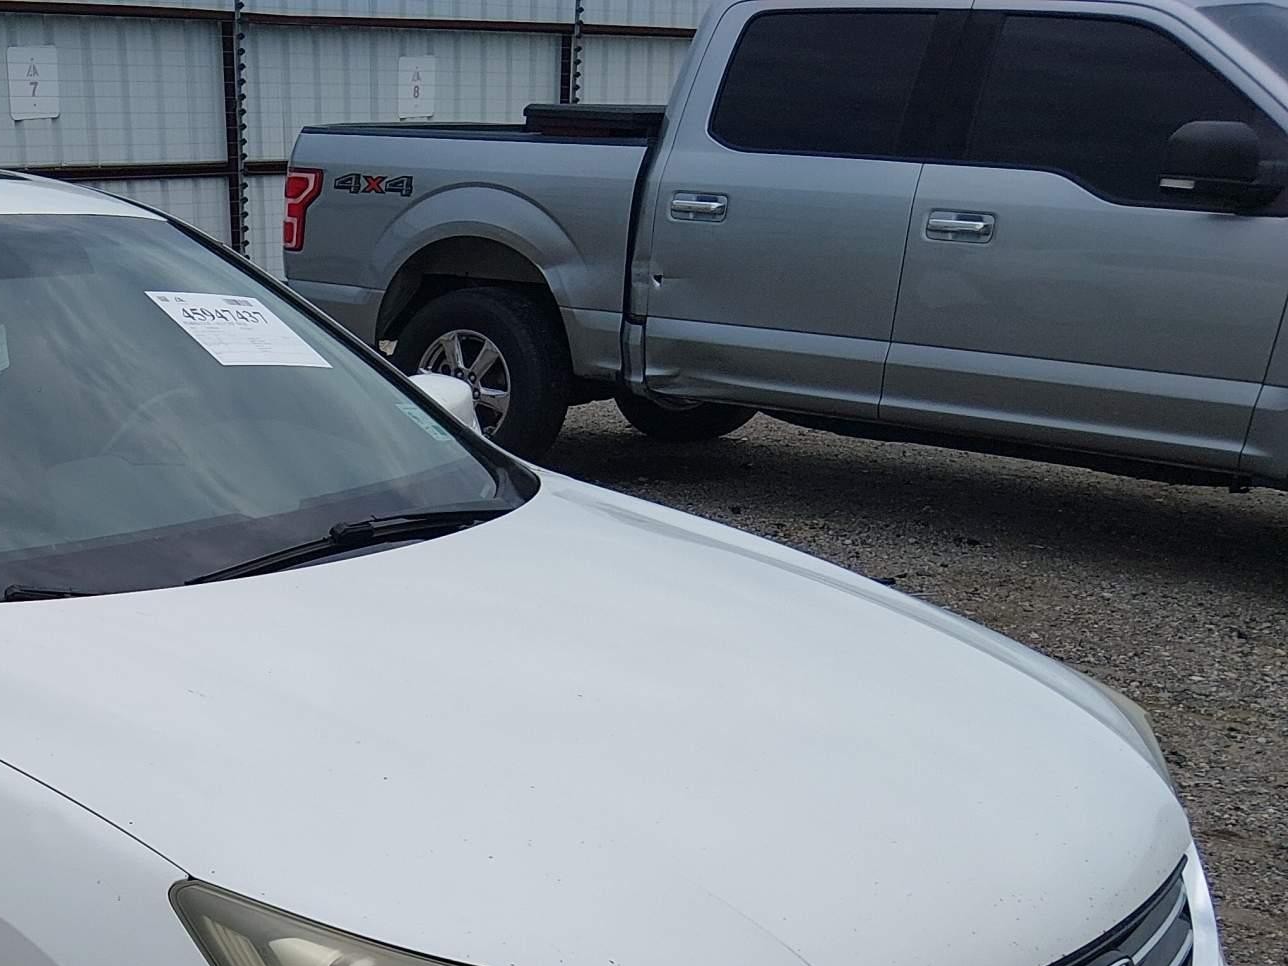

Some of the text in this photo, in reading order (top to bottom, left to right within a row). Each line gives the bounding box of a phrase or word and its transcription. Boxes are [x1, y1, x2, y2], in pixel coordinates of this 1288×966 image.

[29, 81, 39, 97] 7
[413, 85, 420, 98] 8
[181, 307, 268, 324] 45947437
